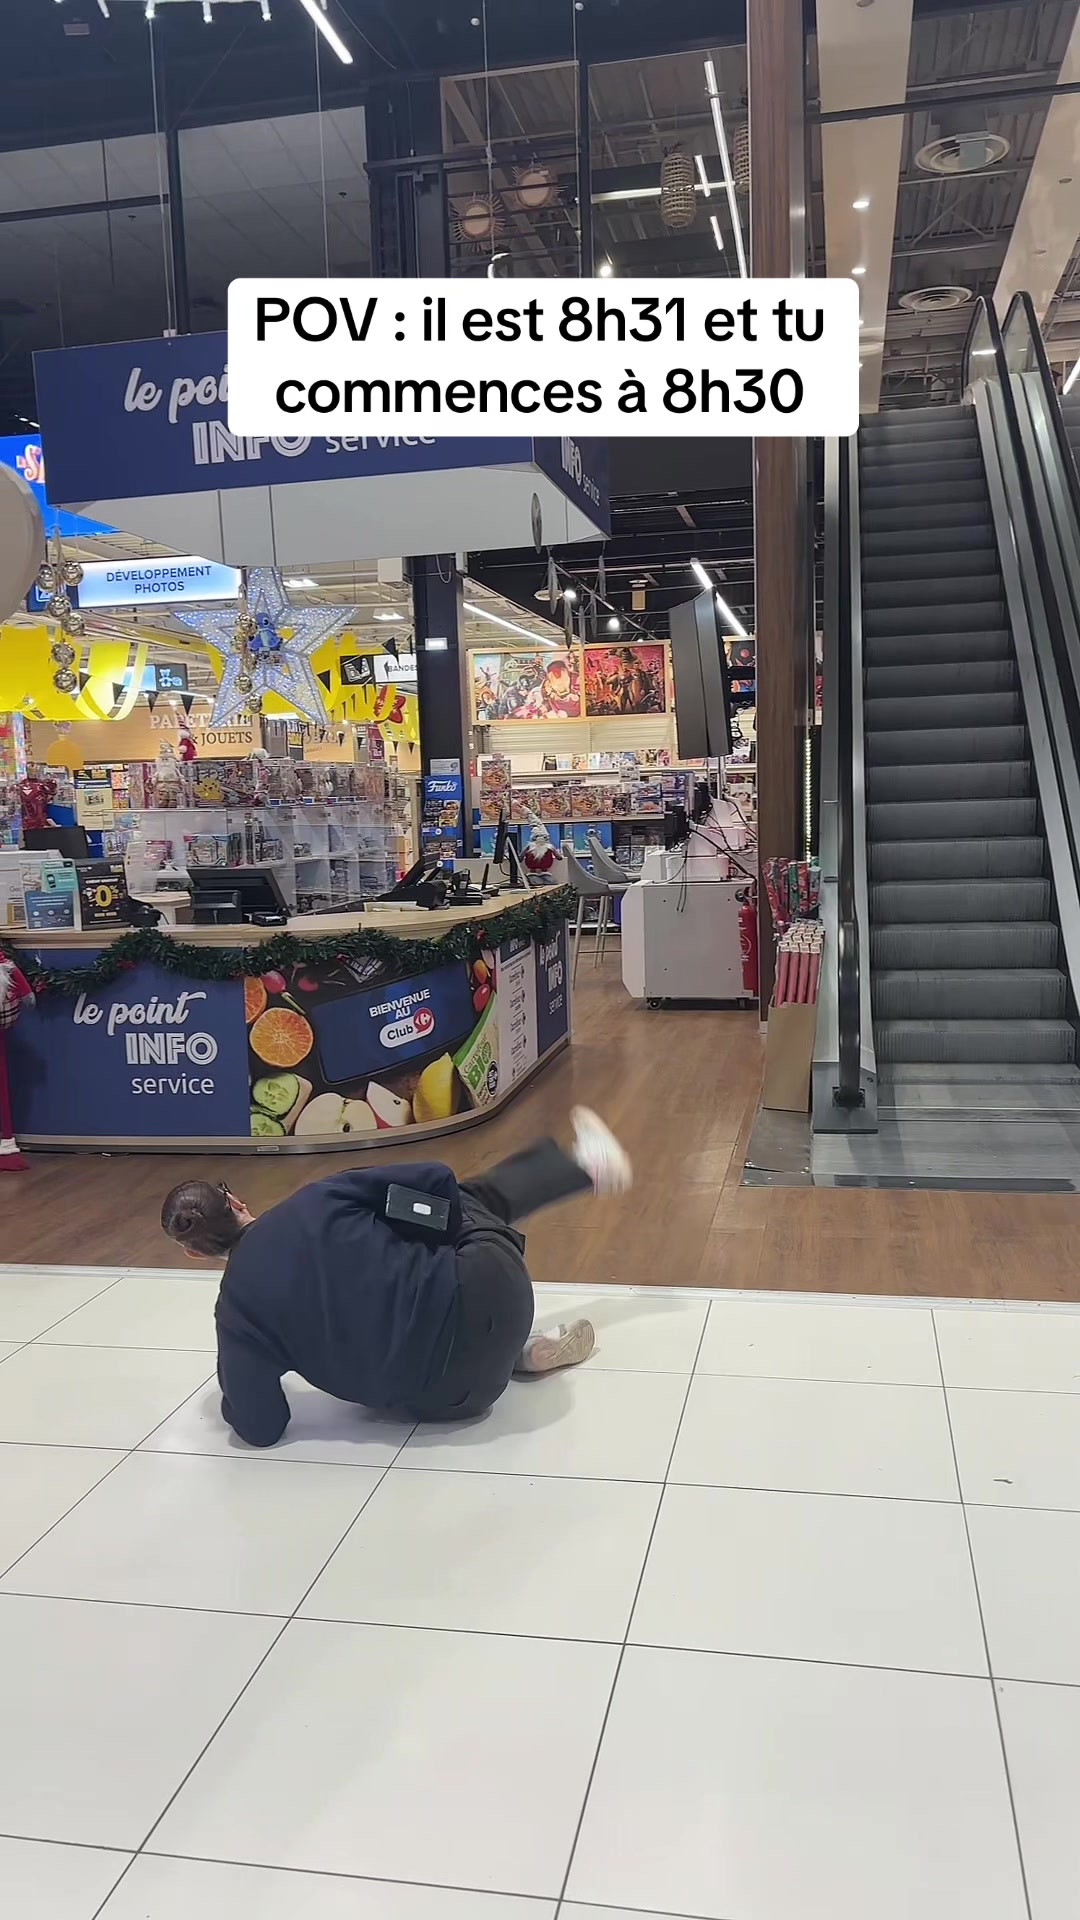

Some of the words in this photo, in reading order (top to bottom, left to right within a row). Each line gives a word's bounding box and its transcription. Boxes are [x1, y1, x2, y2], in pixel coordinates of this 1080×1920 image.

[124, 367, 163, 412] le
[106, 565, 212, 583] DÉVELOPPEMENT
[134, 581, 185, 594] PHOTOS
[201, 731, 253, 746] JOUETS
[427, 780, 458, 793] Funko
[548, 960, 563, 993] INFO
[368, 988, 431, 1018] BIENVENUE
[395, 1005, 411, 1020] AU
[73, 992, 103, 1025] le
[107, 991, 207, 1036] point
[386, 1024, 414, 1041] Club
[125, 1032, 218, 1066] INFO
[131, 1072, 215, 1095] service
